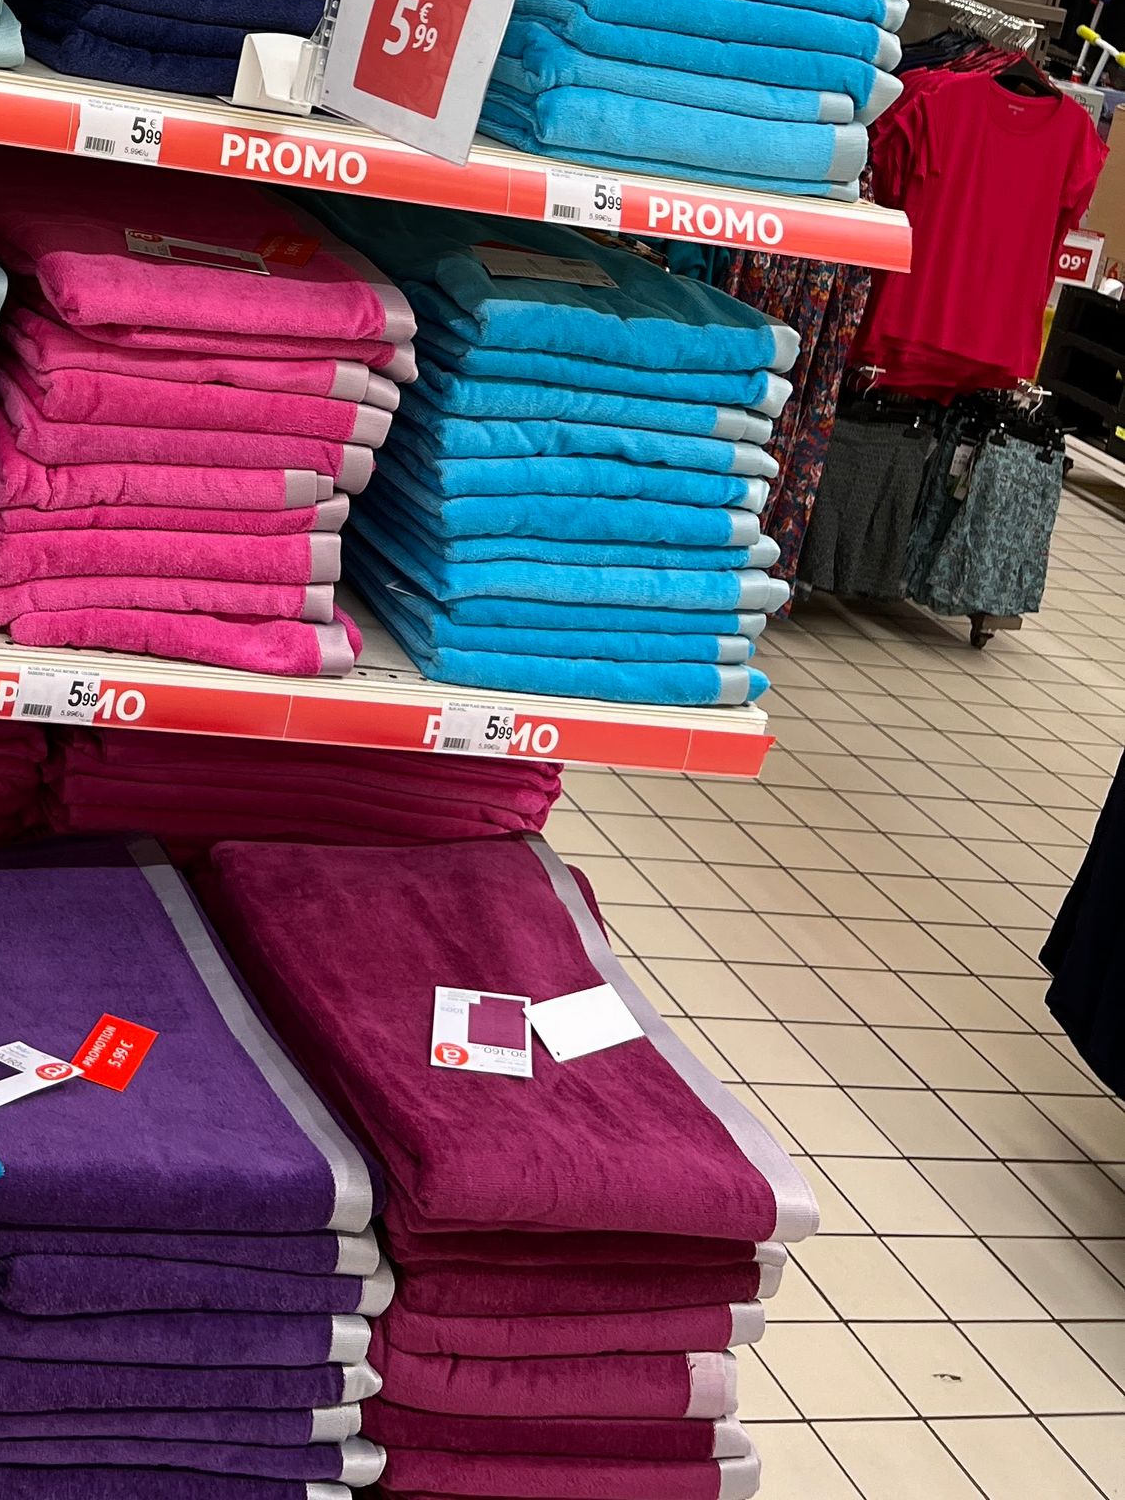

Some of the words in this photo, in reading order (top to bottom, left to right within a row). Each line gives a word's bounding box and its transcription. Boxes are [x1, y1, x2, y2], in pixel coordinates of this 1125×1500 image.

[219, 132, 367, 185] PROMO
[648, 195, 784, 245] PROMO
[82, 1025, 117, 1067] PROMOTION
